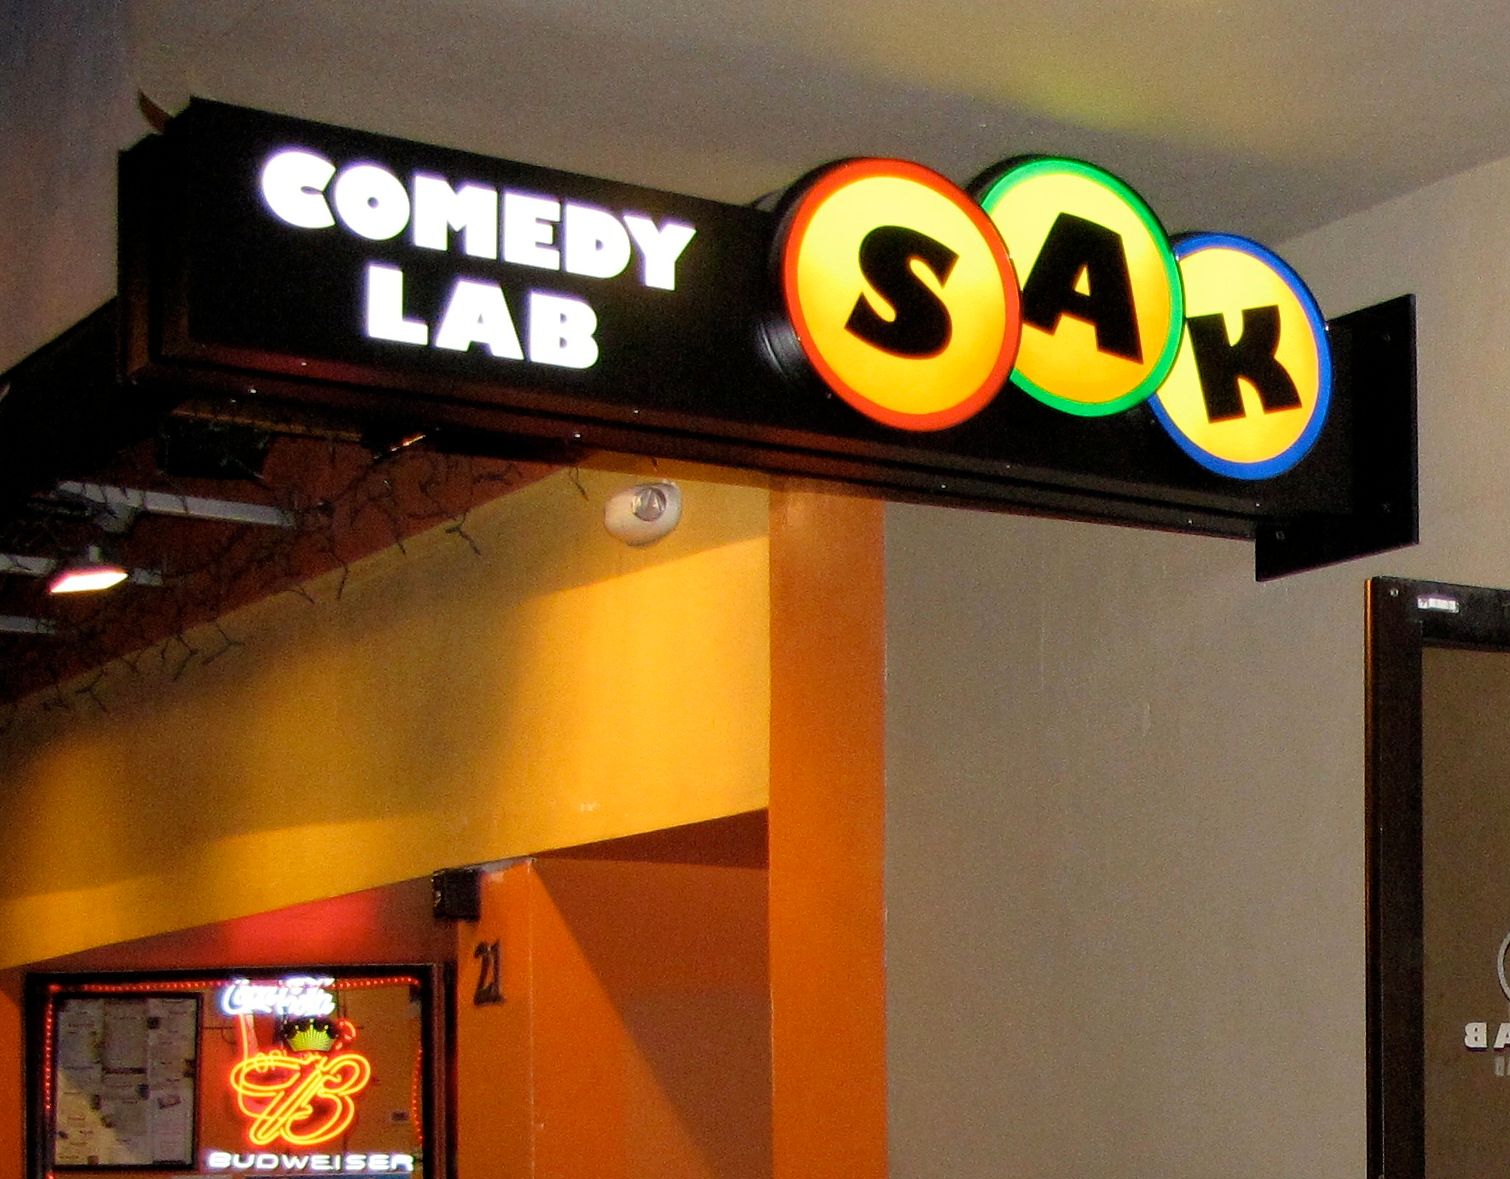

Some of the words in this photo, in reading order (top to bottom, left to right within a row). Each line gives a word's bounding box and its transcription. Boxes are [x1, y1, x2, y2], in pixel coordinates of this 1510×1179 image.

[260, 149, 696, 291] COMEDY
[367, 265, 600, 370] LAB
[844, 212, 1303, 425] SAK
[473, 939, 507, 1005] 21
[208, 1152, 414, 1171] BUDWEISER
